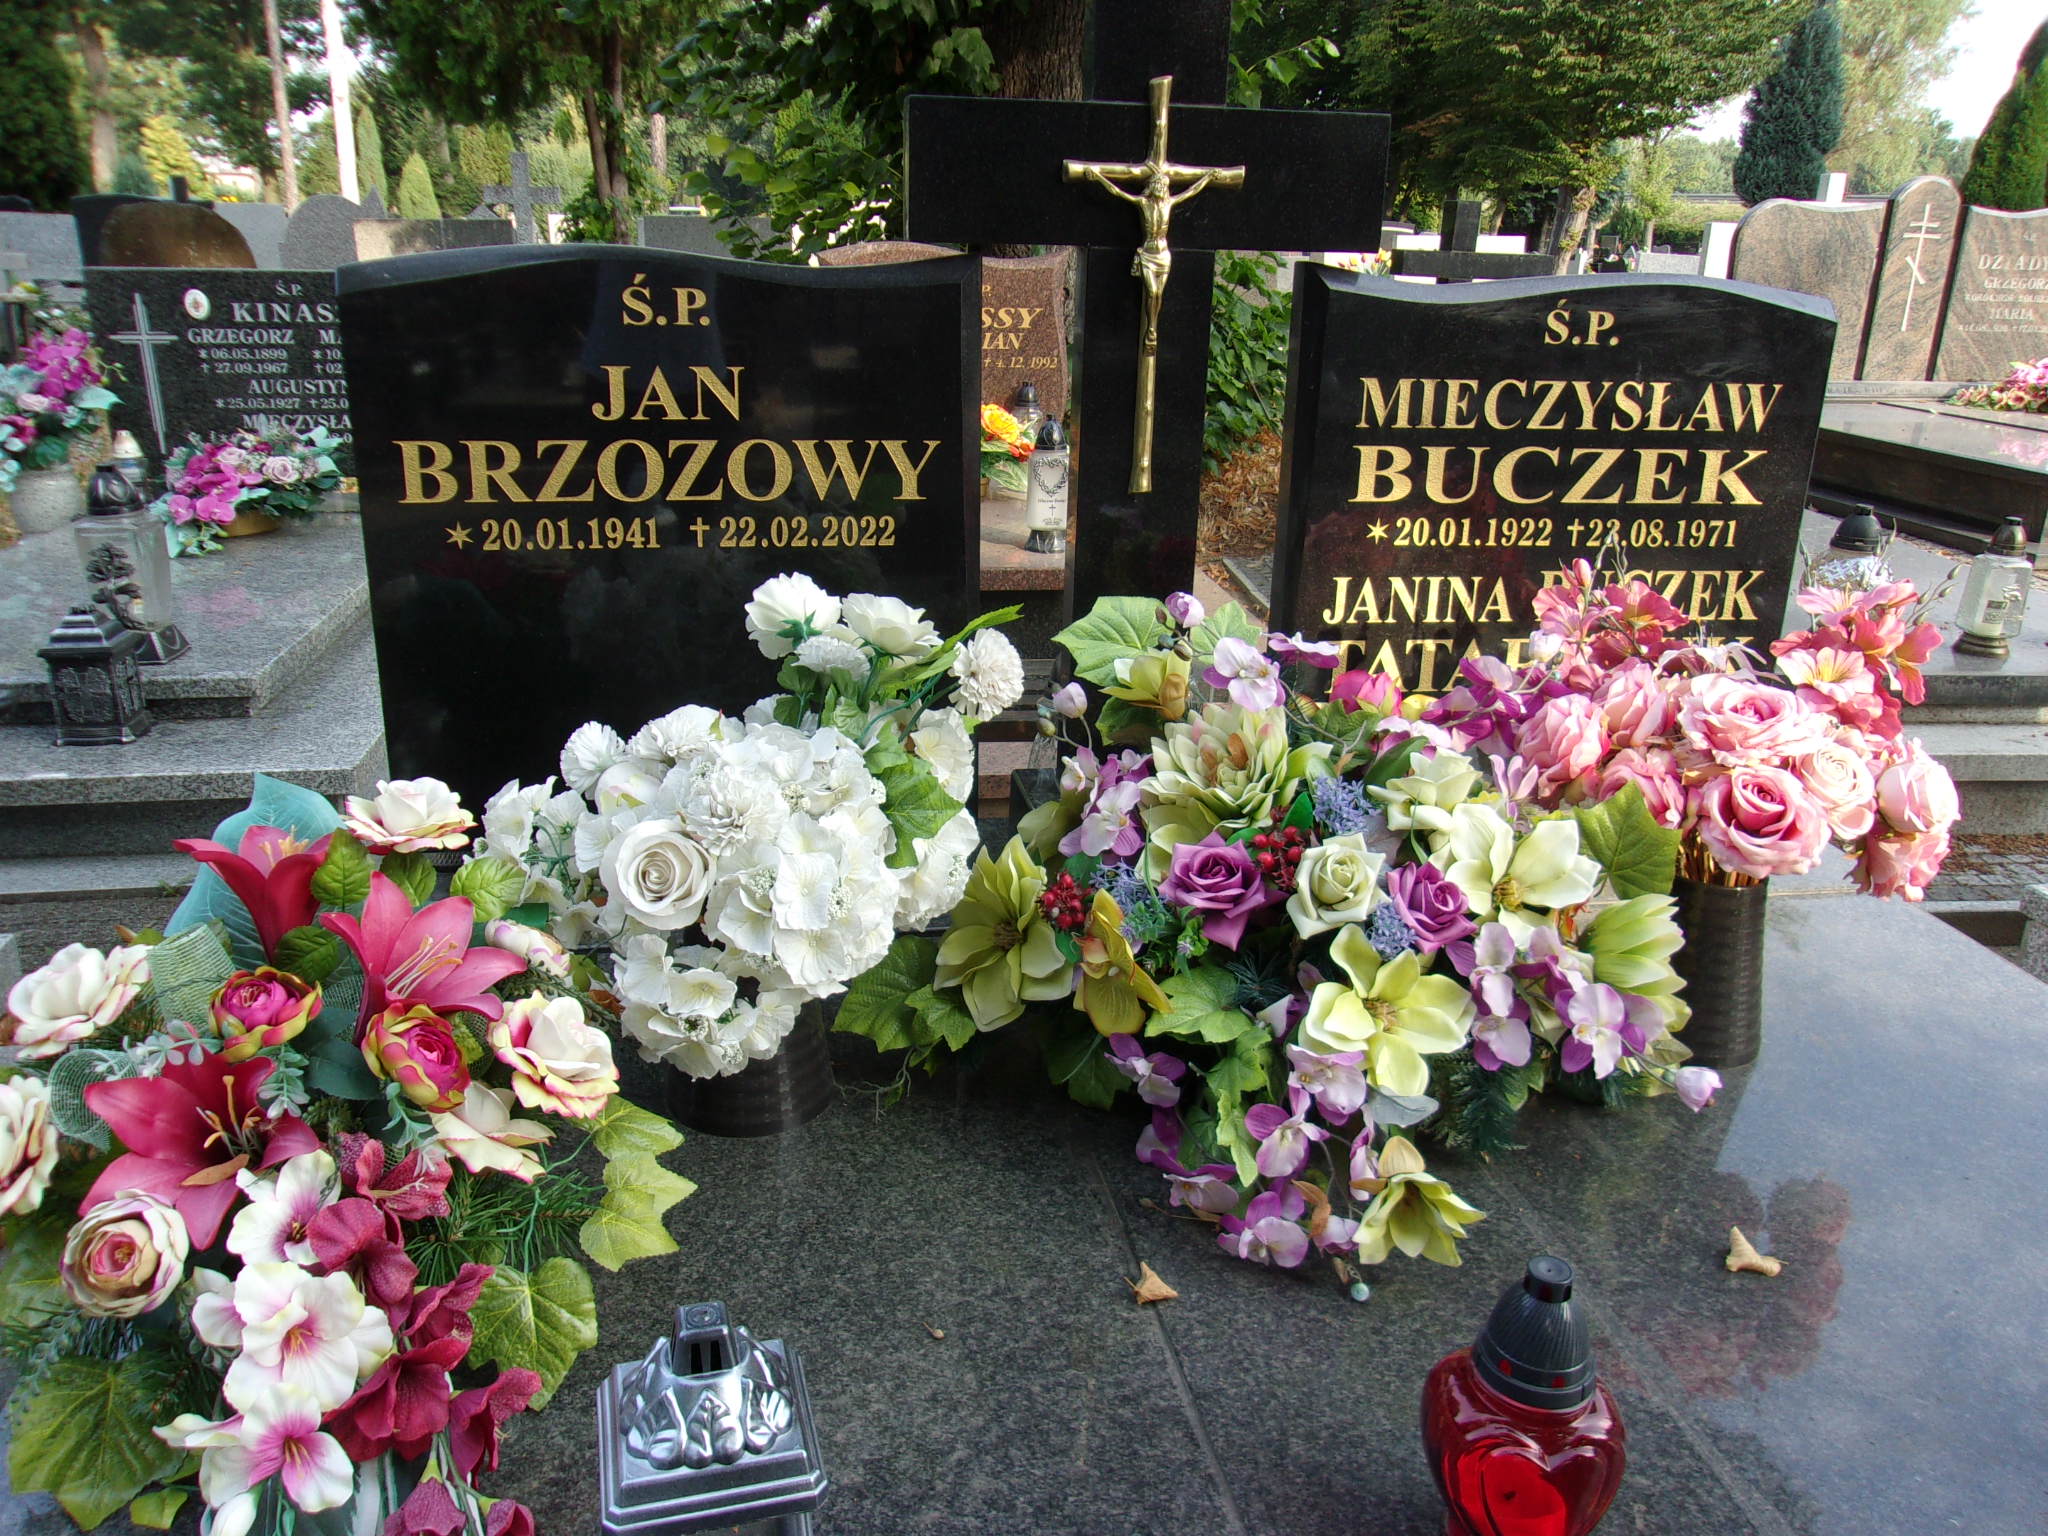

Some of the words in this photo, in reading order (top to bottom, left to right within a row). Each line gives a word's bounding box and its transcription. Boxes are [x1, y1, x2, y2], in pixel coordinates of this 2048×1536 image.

[230, 302, 341, 323] KINAS
[621, 273, 711, 326] Ś.P.
[187, 328, 295, 344] GRZEGORZ
[1543, 299, 1620, 346] Ś.P.
[210, 348, 289, 360] 06.05.1899
[213, 361, 289, 375] 27.09.1967
[1030, 356, 1058, 370] 1992
[227, 397, 301, 409] 25.05.1927
[591, 364, 745, 422] JAN
[1355, 376, 1784, 433] MIECZYSŁAW
[392, 438, 942, 504] BRZOZOWY
[1347, 444, 1768, 506] BUCZEK
[481, 516, 659, 551] 20.01.1941
[719, 514, 896, 549] 22.02.2022
[1393, 517, 1554, 547] 20.01.1922
[1586, 518, 1738, 548] 23.08.1971
[1322, 575, 1513, 625] JANINA
